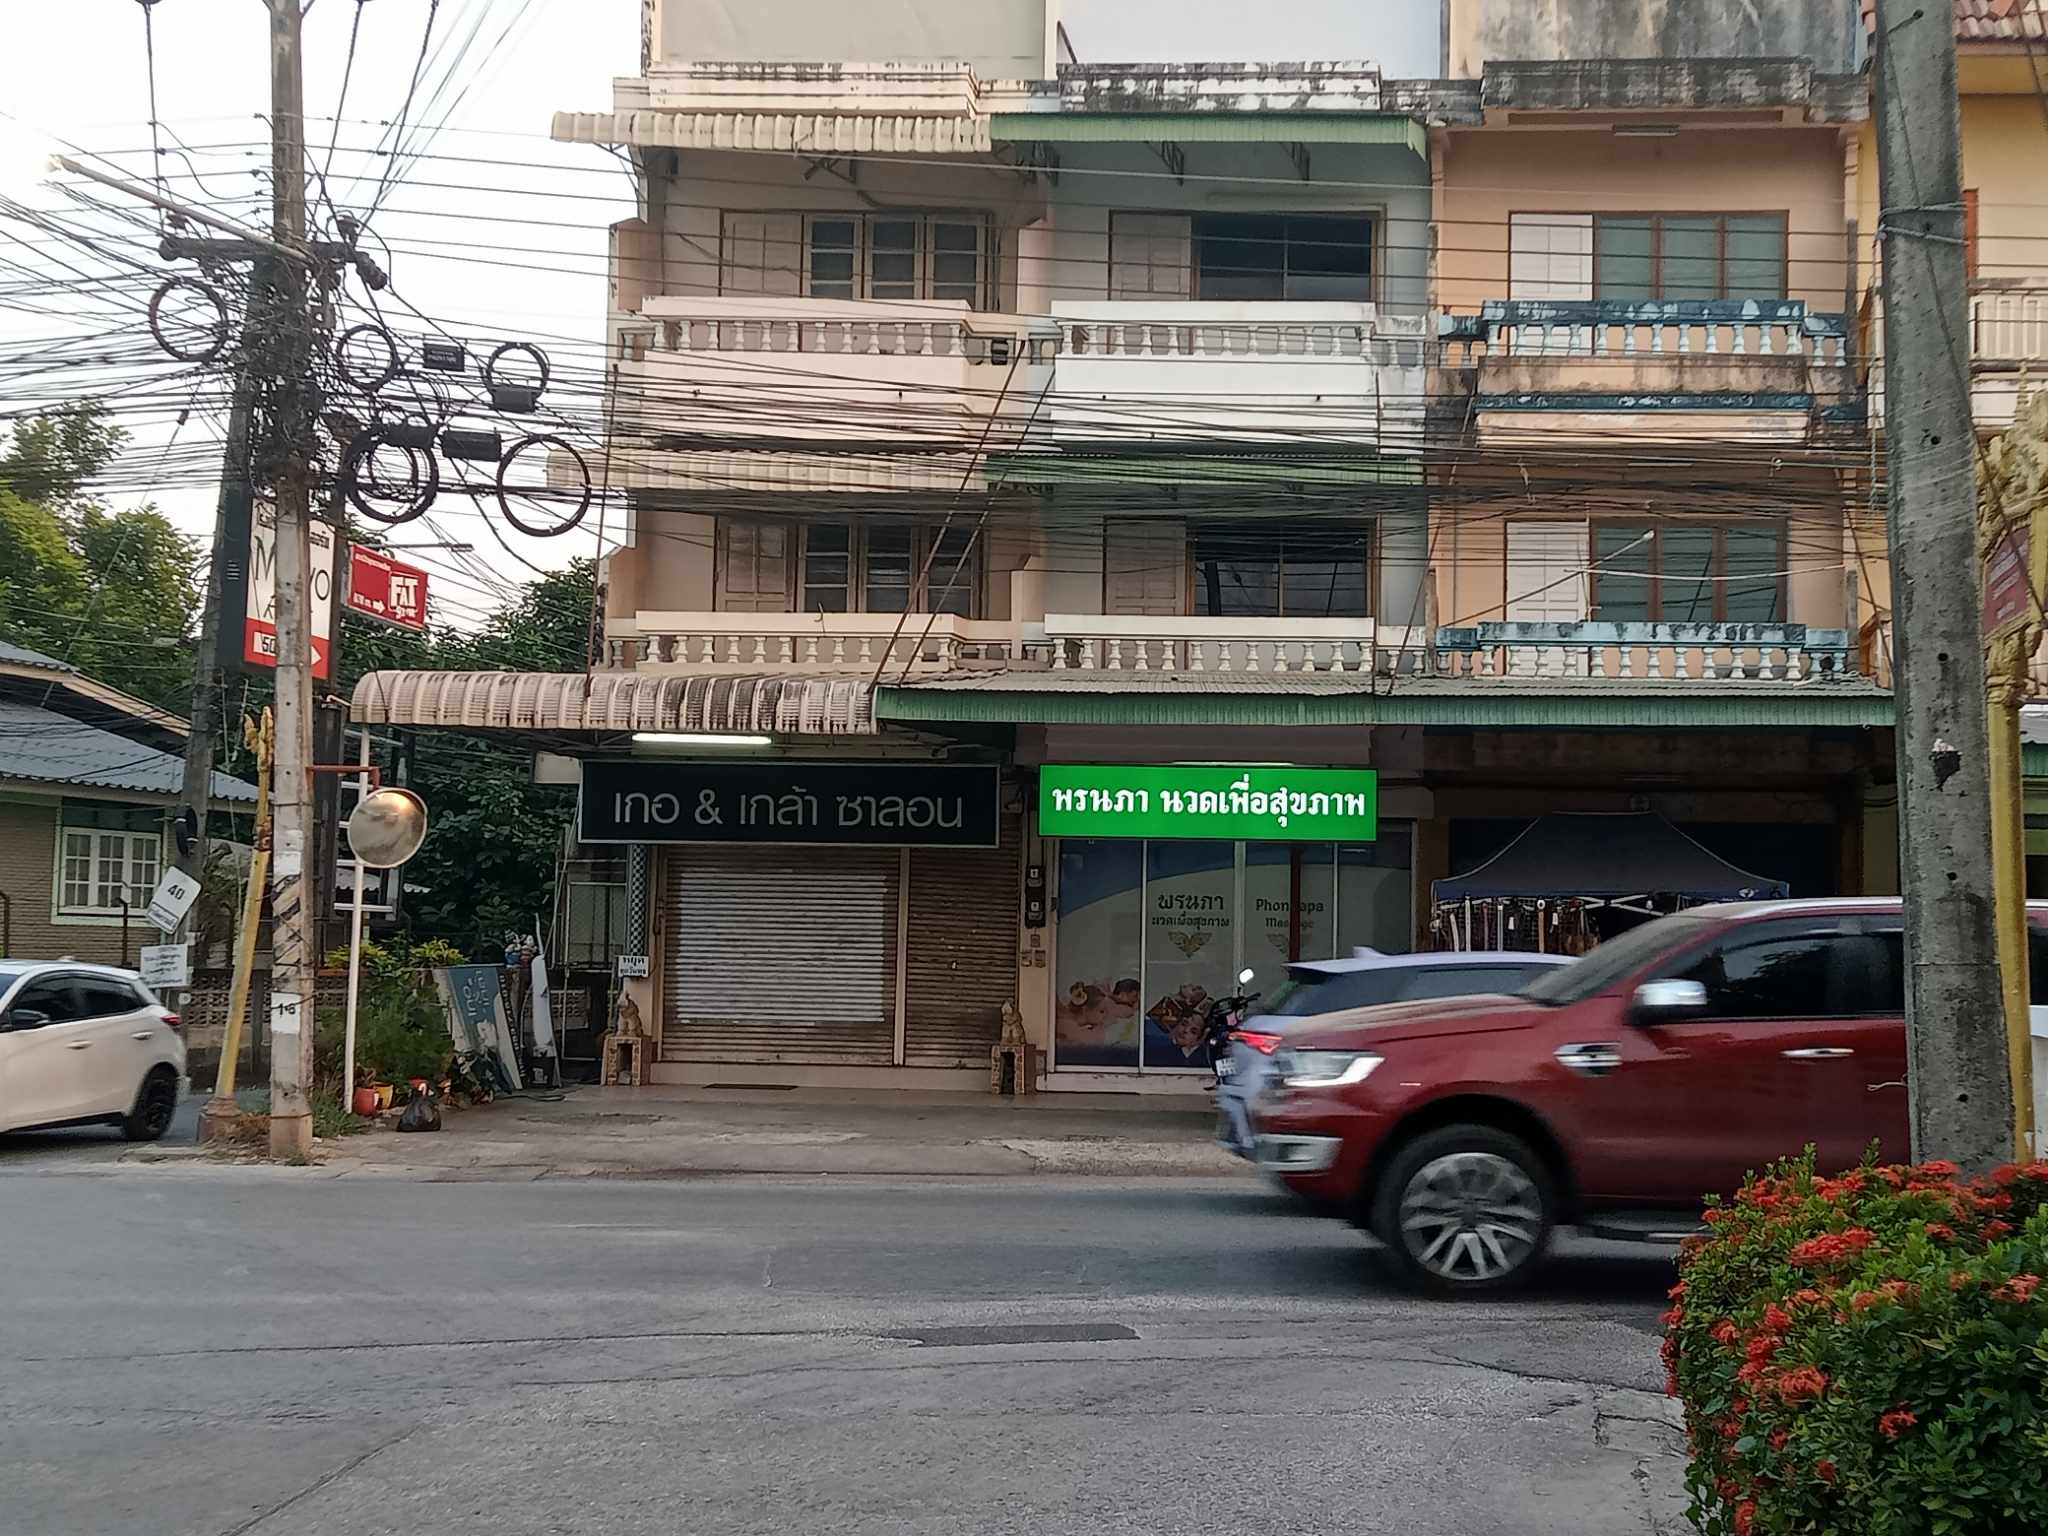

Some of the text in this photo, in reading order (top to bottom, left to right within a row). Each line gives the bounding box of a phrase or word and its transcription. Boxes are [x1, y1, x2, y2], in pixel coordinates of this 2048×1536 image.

[390, 575, 418, 608] FAT
[614, 785, 963, 828] เกอ & เกล้า ซาลอน
[1052, 773, 1366, 828] พรนภา นวดเพื่อสุขภาพ
[167, 884, 186, 901] 40
[1158, 894, 1225, 911] พรนภา
[1255, 898, 1325, 914] Phonapa
